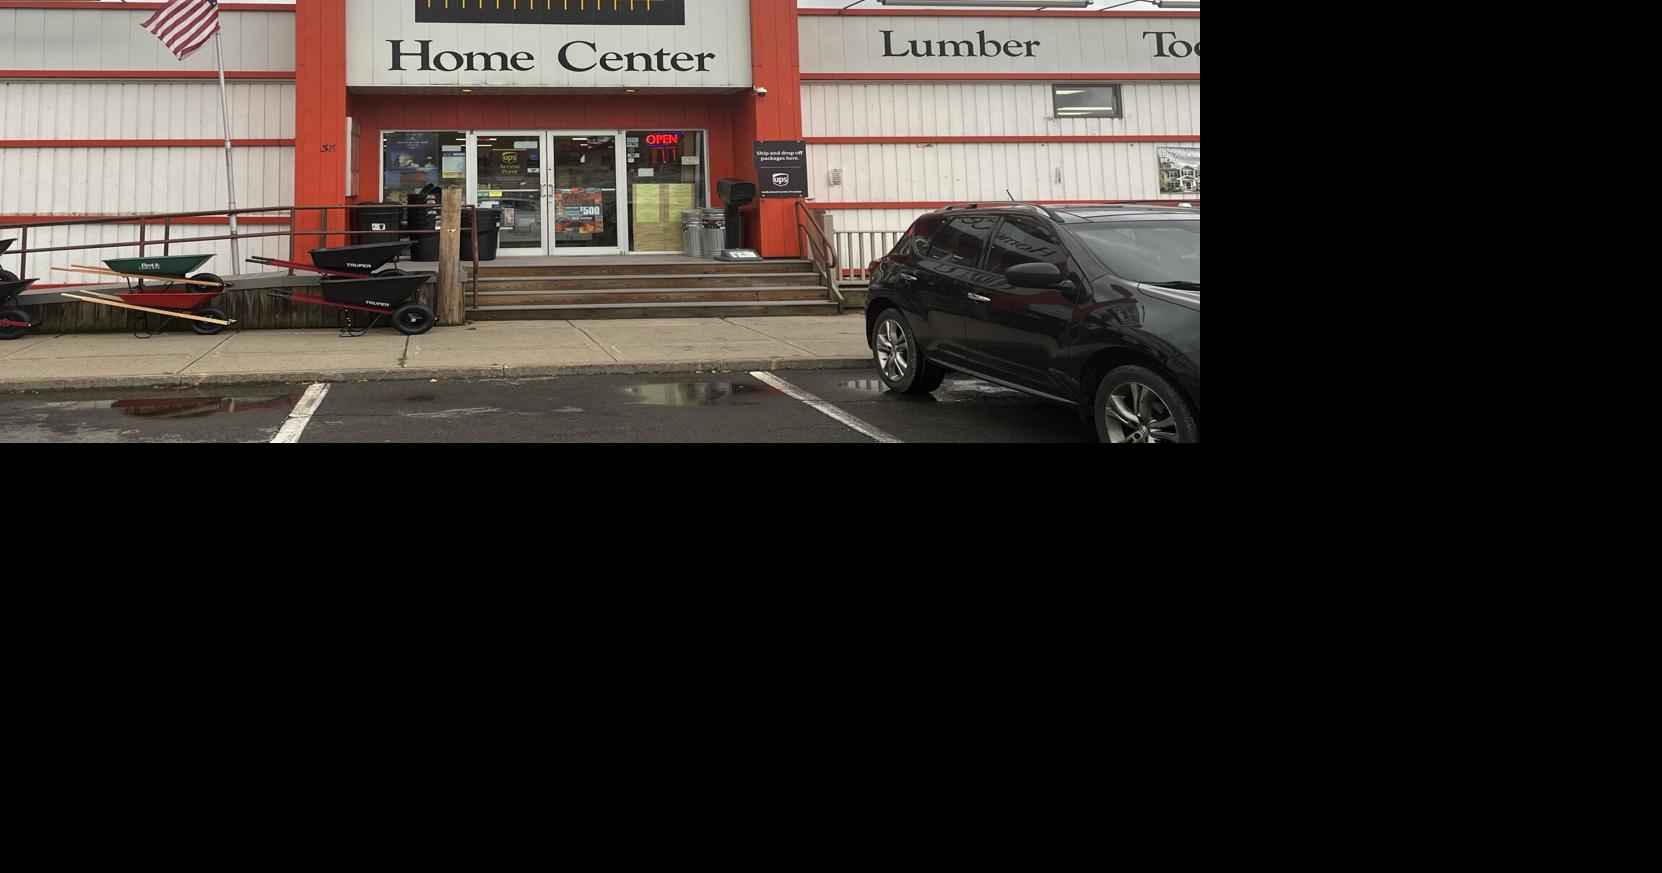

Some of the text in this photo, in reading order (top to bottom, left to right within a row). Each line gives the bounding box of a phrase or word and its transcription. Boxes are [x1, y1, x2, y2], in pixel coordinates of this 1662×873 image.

[385, 39, 716, 73] Home Center
[879, 29, 1041, 57] Lumber
[1142, 30, 1200, 57] To
[645, 134, 679, 145] OPEN
